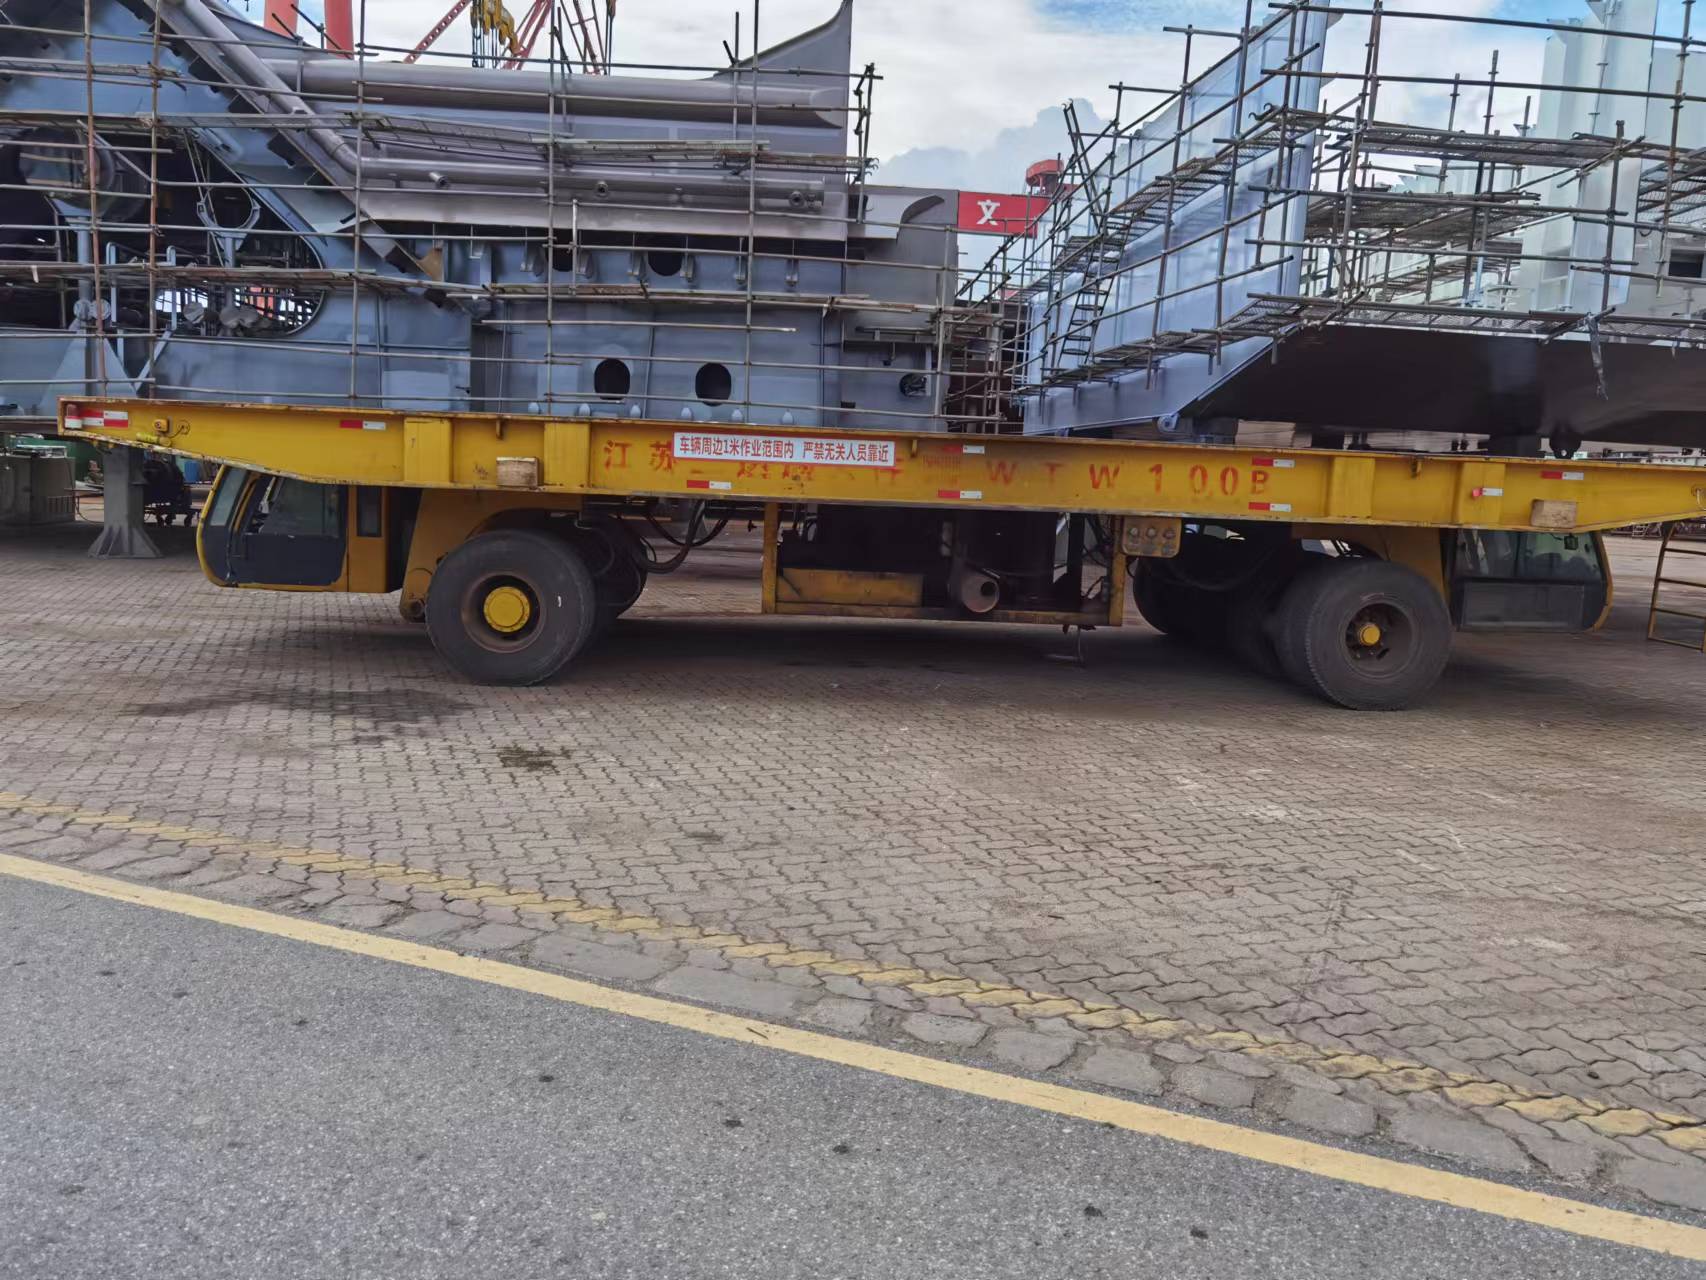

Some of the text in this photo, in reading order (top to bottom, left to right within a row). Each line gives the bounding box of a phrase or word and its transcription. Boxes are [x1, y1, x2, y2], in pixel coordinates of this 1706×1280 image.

[976, 199, 1001, 226] 文
[679, 435, 890, 463] 车辆周边1米作业范围内 严禁无关人员靠近
